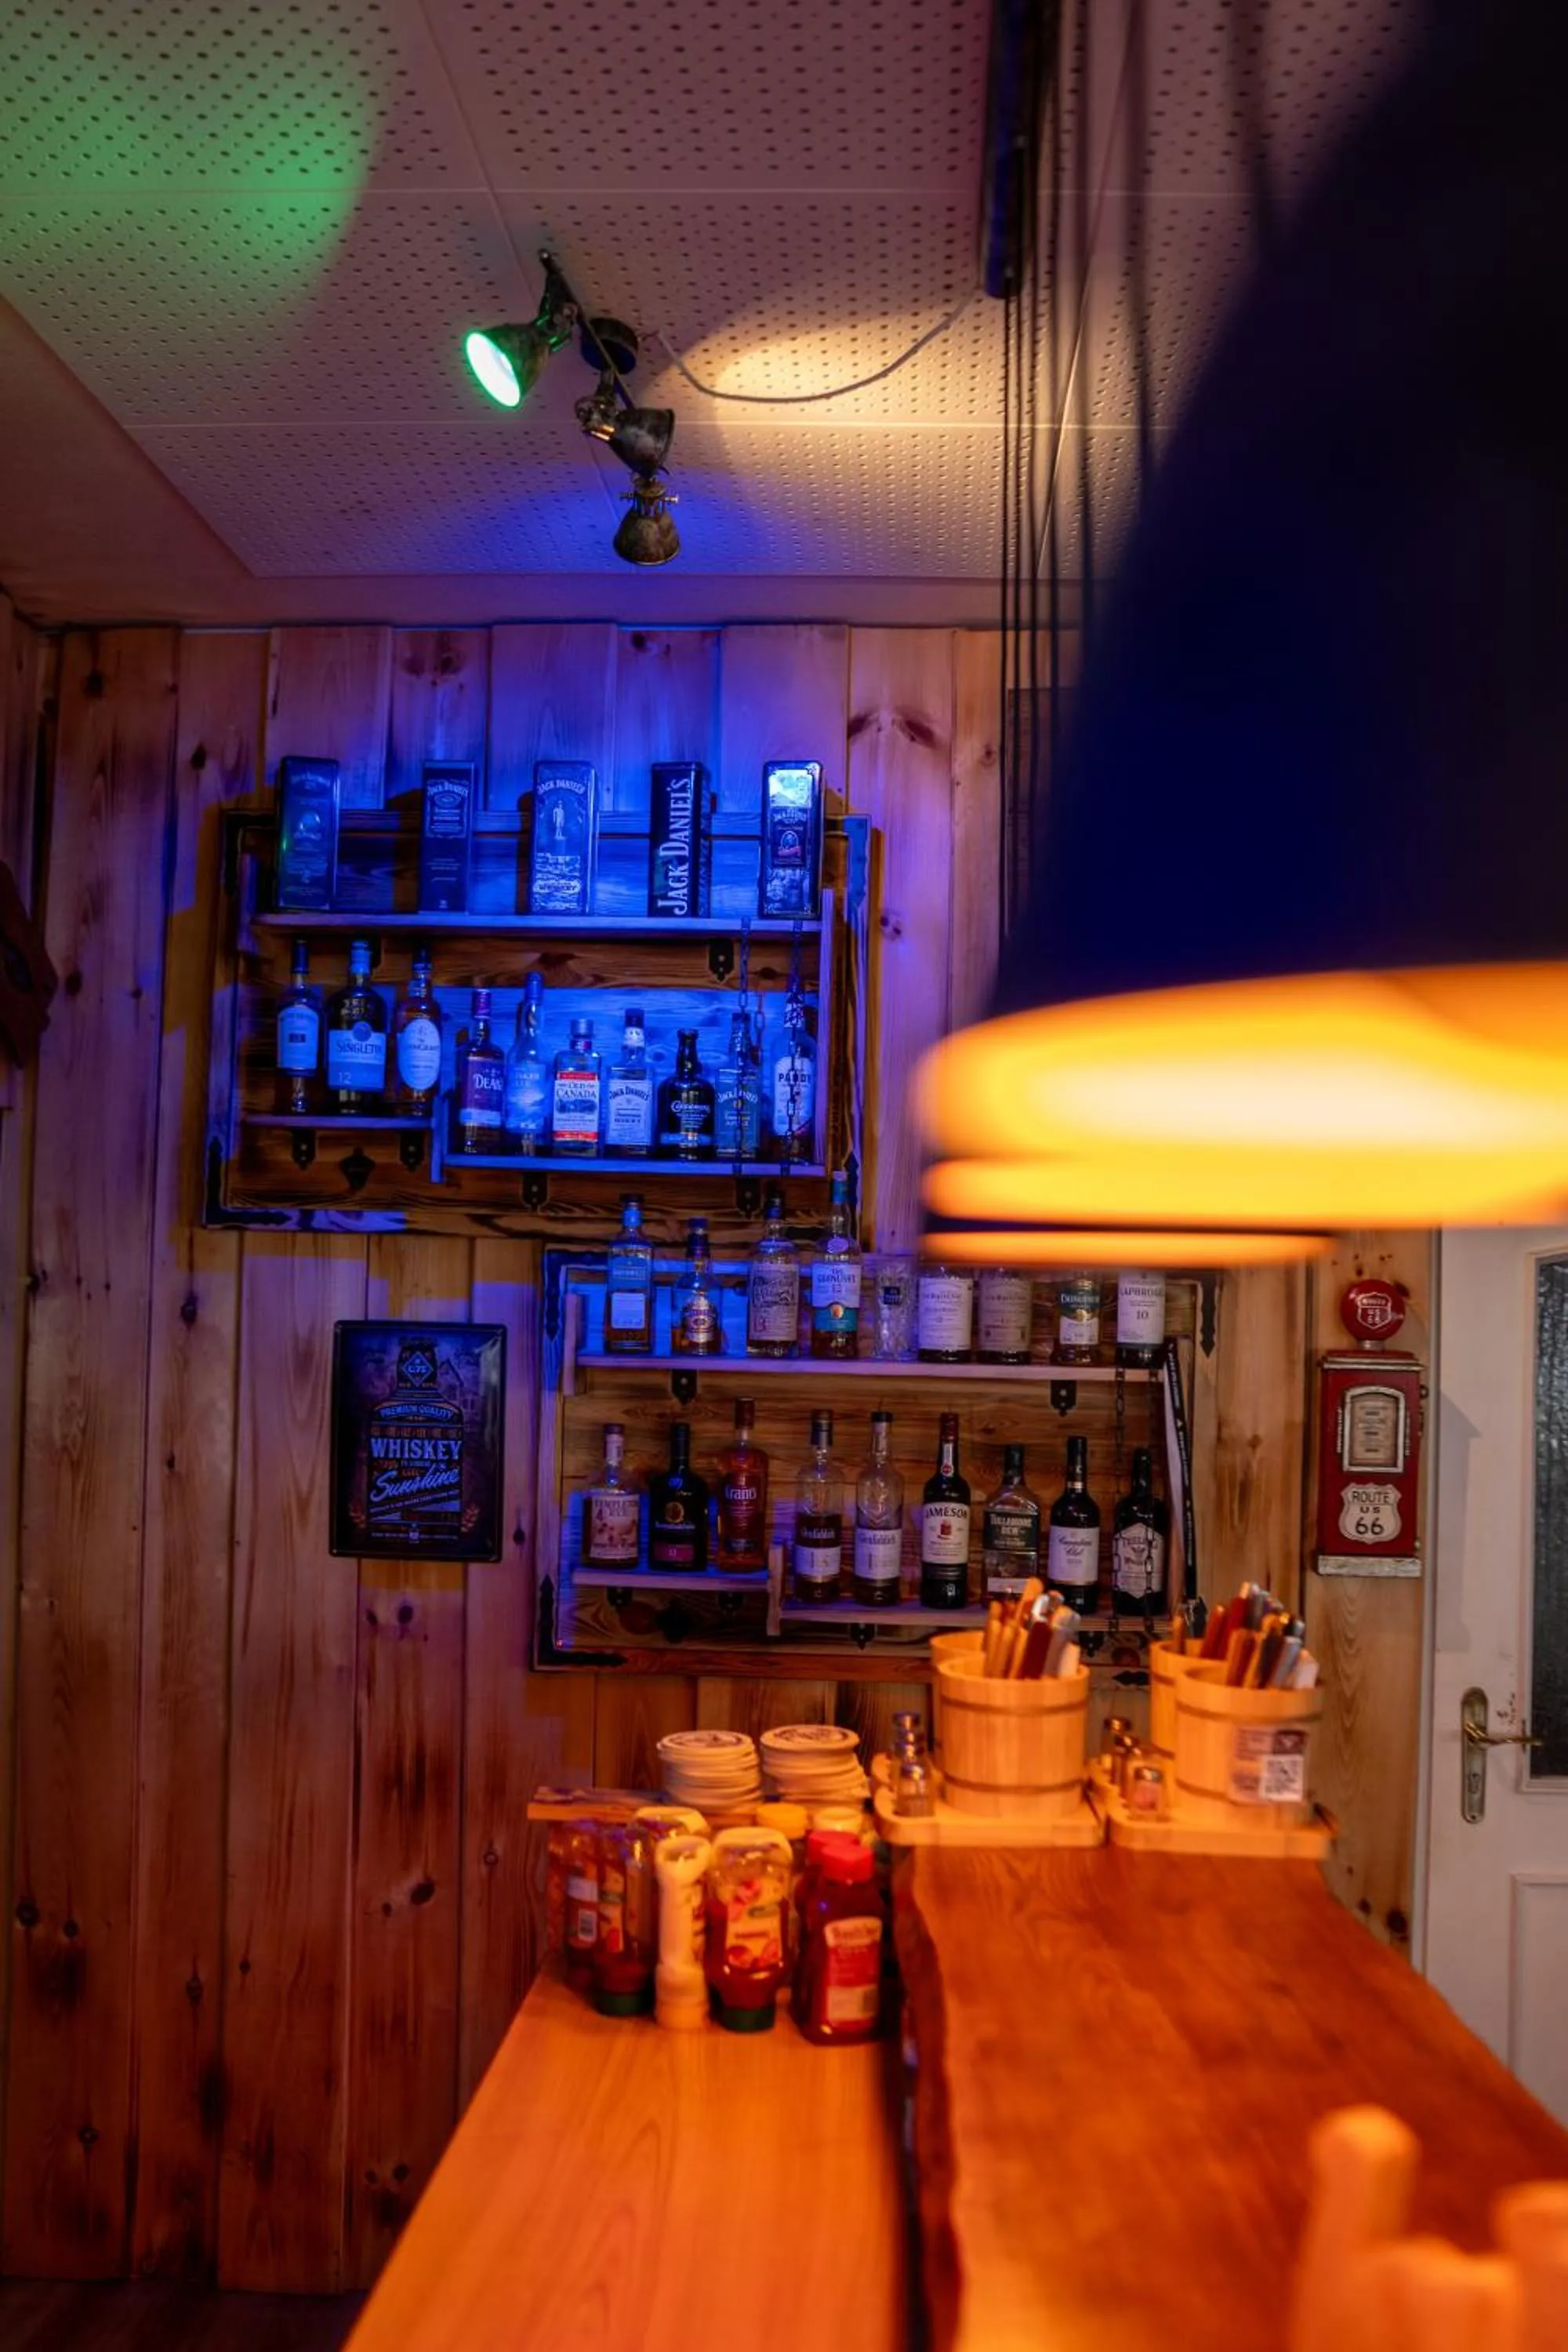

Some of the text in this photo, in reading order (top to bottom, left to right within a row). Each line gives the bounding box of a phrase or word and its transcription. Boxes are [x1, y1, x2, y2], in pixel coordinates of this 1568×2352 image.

[657, 778, 691, 916] JACK DANIEL'S
[339, 1072, 351, 1085] 12
[556, 1088, 597, 1098] CANADA
[1136, 1309, 1149, 1319] 10
[419, 1404, 453, 1419] QUALITY
[370, 1438, 463, 1460] WHISKEY
[369, 1462, 459, 1502] Sunshine
[1352, 1490, 1389, 1504] ROUTE
[924, 1504, 969, 1519] JAMESON
[1355, 1518, 1385, 1536] 66
